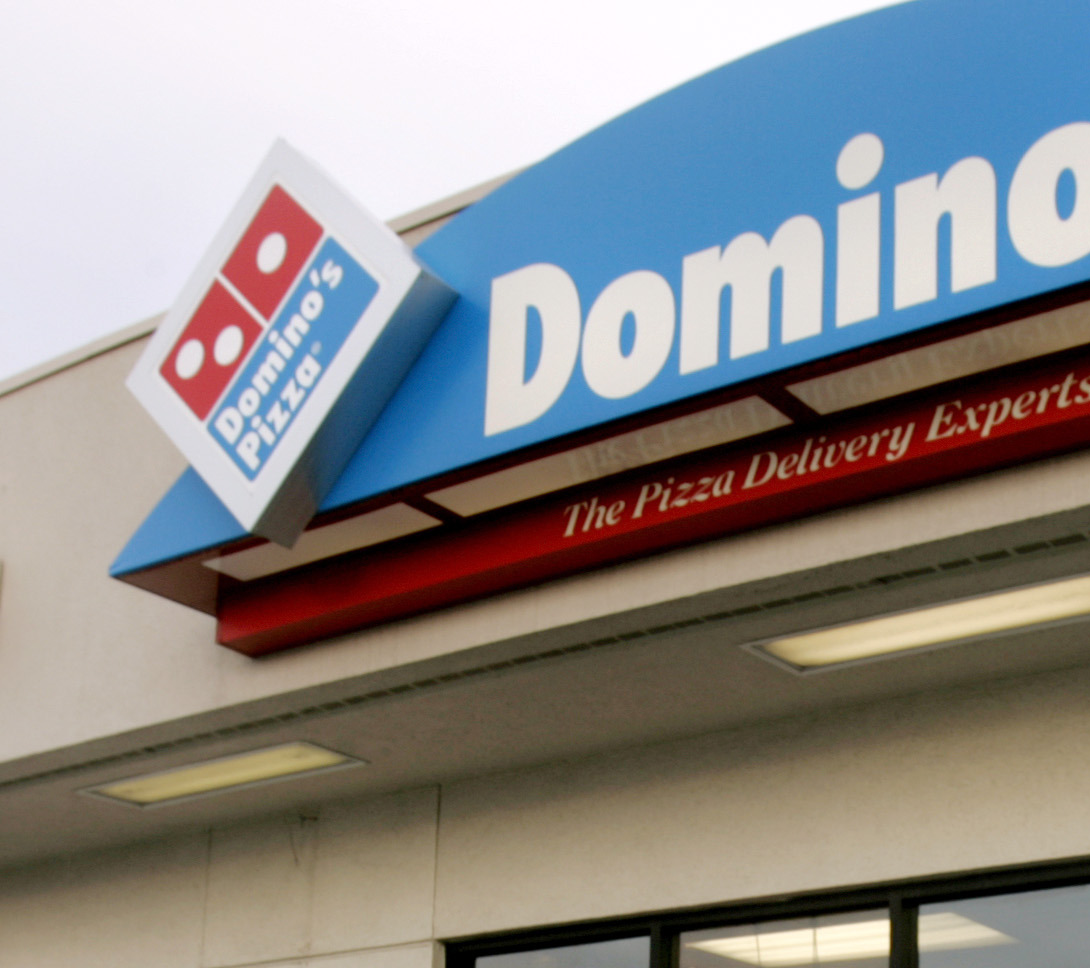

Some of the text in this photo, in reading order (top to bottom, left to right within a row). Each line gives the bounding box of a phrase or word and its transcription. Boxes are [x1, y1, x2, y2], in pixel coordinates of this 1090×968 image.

[214, 259, 344, 445] Domino's
[236, 354, 322, 471] Pizza
[563, 502, 626, 537] The
[631, 470, 733, 519] Pizza
[741, 420, 914, 490] Delivery
